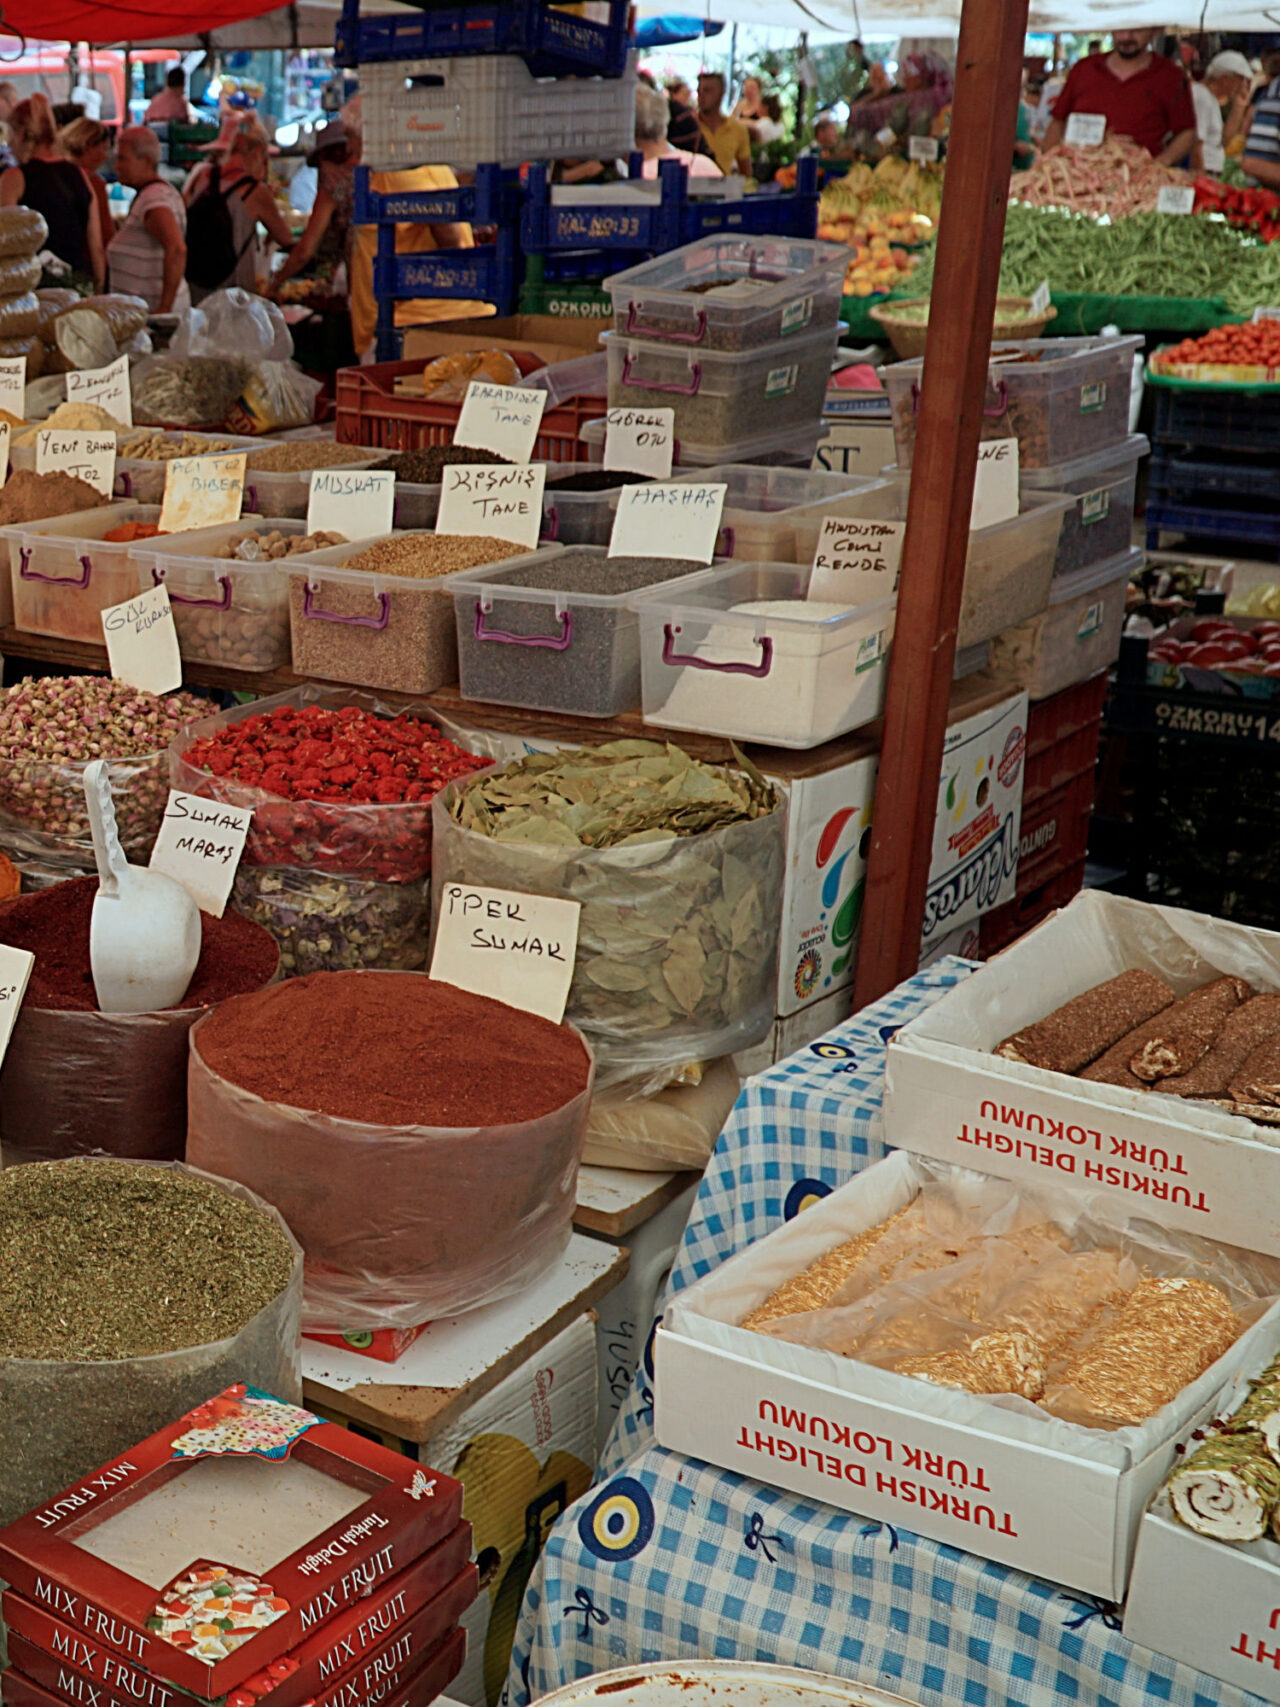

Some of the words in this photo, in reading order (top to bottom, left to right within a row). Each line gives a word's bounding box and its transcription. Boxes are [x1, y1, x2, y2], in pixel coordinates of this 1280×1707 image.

[472, 498, 530, 518] TANE
[816, 555, 888, 572] RENDE
[165, 795, 245, 831] SUMAK
[470, 927, 567, 962] SUMAK
[956, 1124, 1077, 1174] DELIGHT
[979, 1100, 1103, 1151] LOKUMU
[1108, 1135, 1189, 1176] TÜRK
[1084, 1159, 1211, 1214] TURKISH
[758, 1399, 894, 1462] LOKUMU
[91, 1461, 138, 1490] MIX
[736, 1426, 868, 1488] DELIGHT
[901, 1443, 992, 1493] TÜRK
[35, 1487, 98, 1528] FRUIT
[349, 1512, 389, 1545] Turkish
[875, 1471, 1019, 1538] TURKISH
[297, 1540, 348, 1577] Delight
[299, 1586, 339, 1632] MIX
[340, 1544, 395, 1600] FRUIT
[34, 1576, 78, 1619] MIX
[83, 1603, 152, 1659] FRUIT
[318, 1634, 356, 1682] MIX
[357, 1590, 408, 1648] FRUIT
[52, 1628, 98, 1673] MIX
[103, 1657, 174, 1707] FRUIT
[363, 1632, 413, 1690] FRUIT
[57, 1668, 102, 1707] MIX
